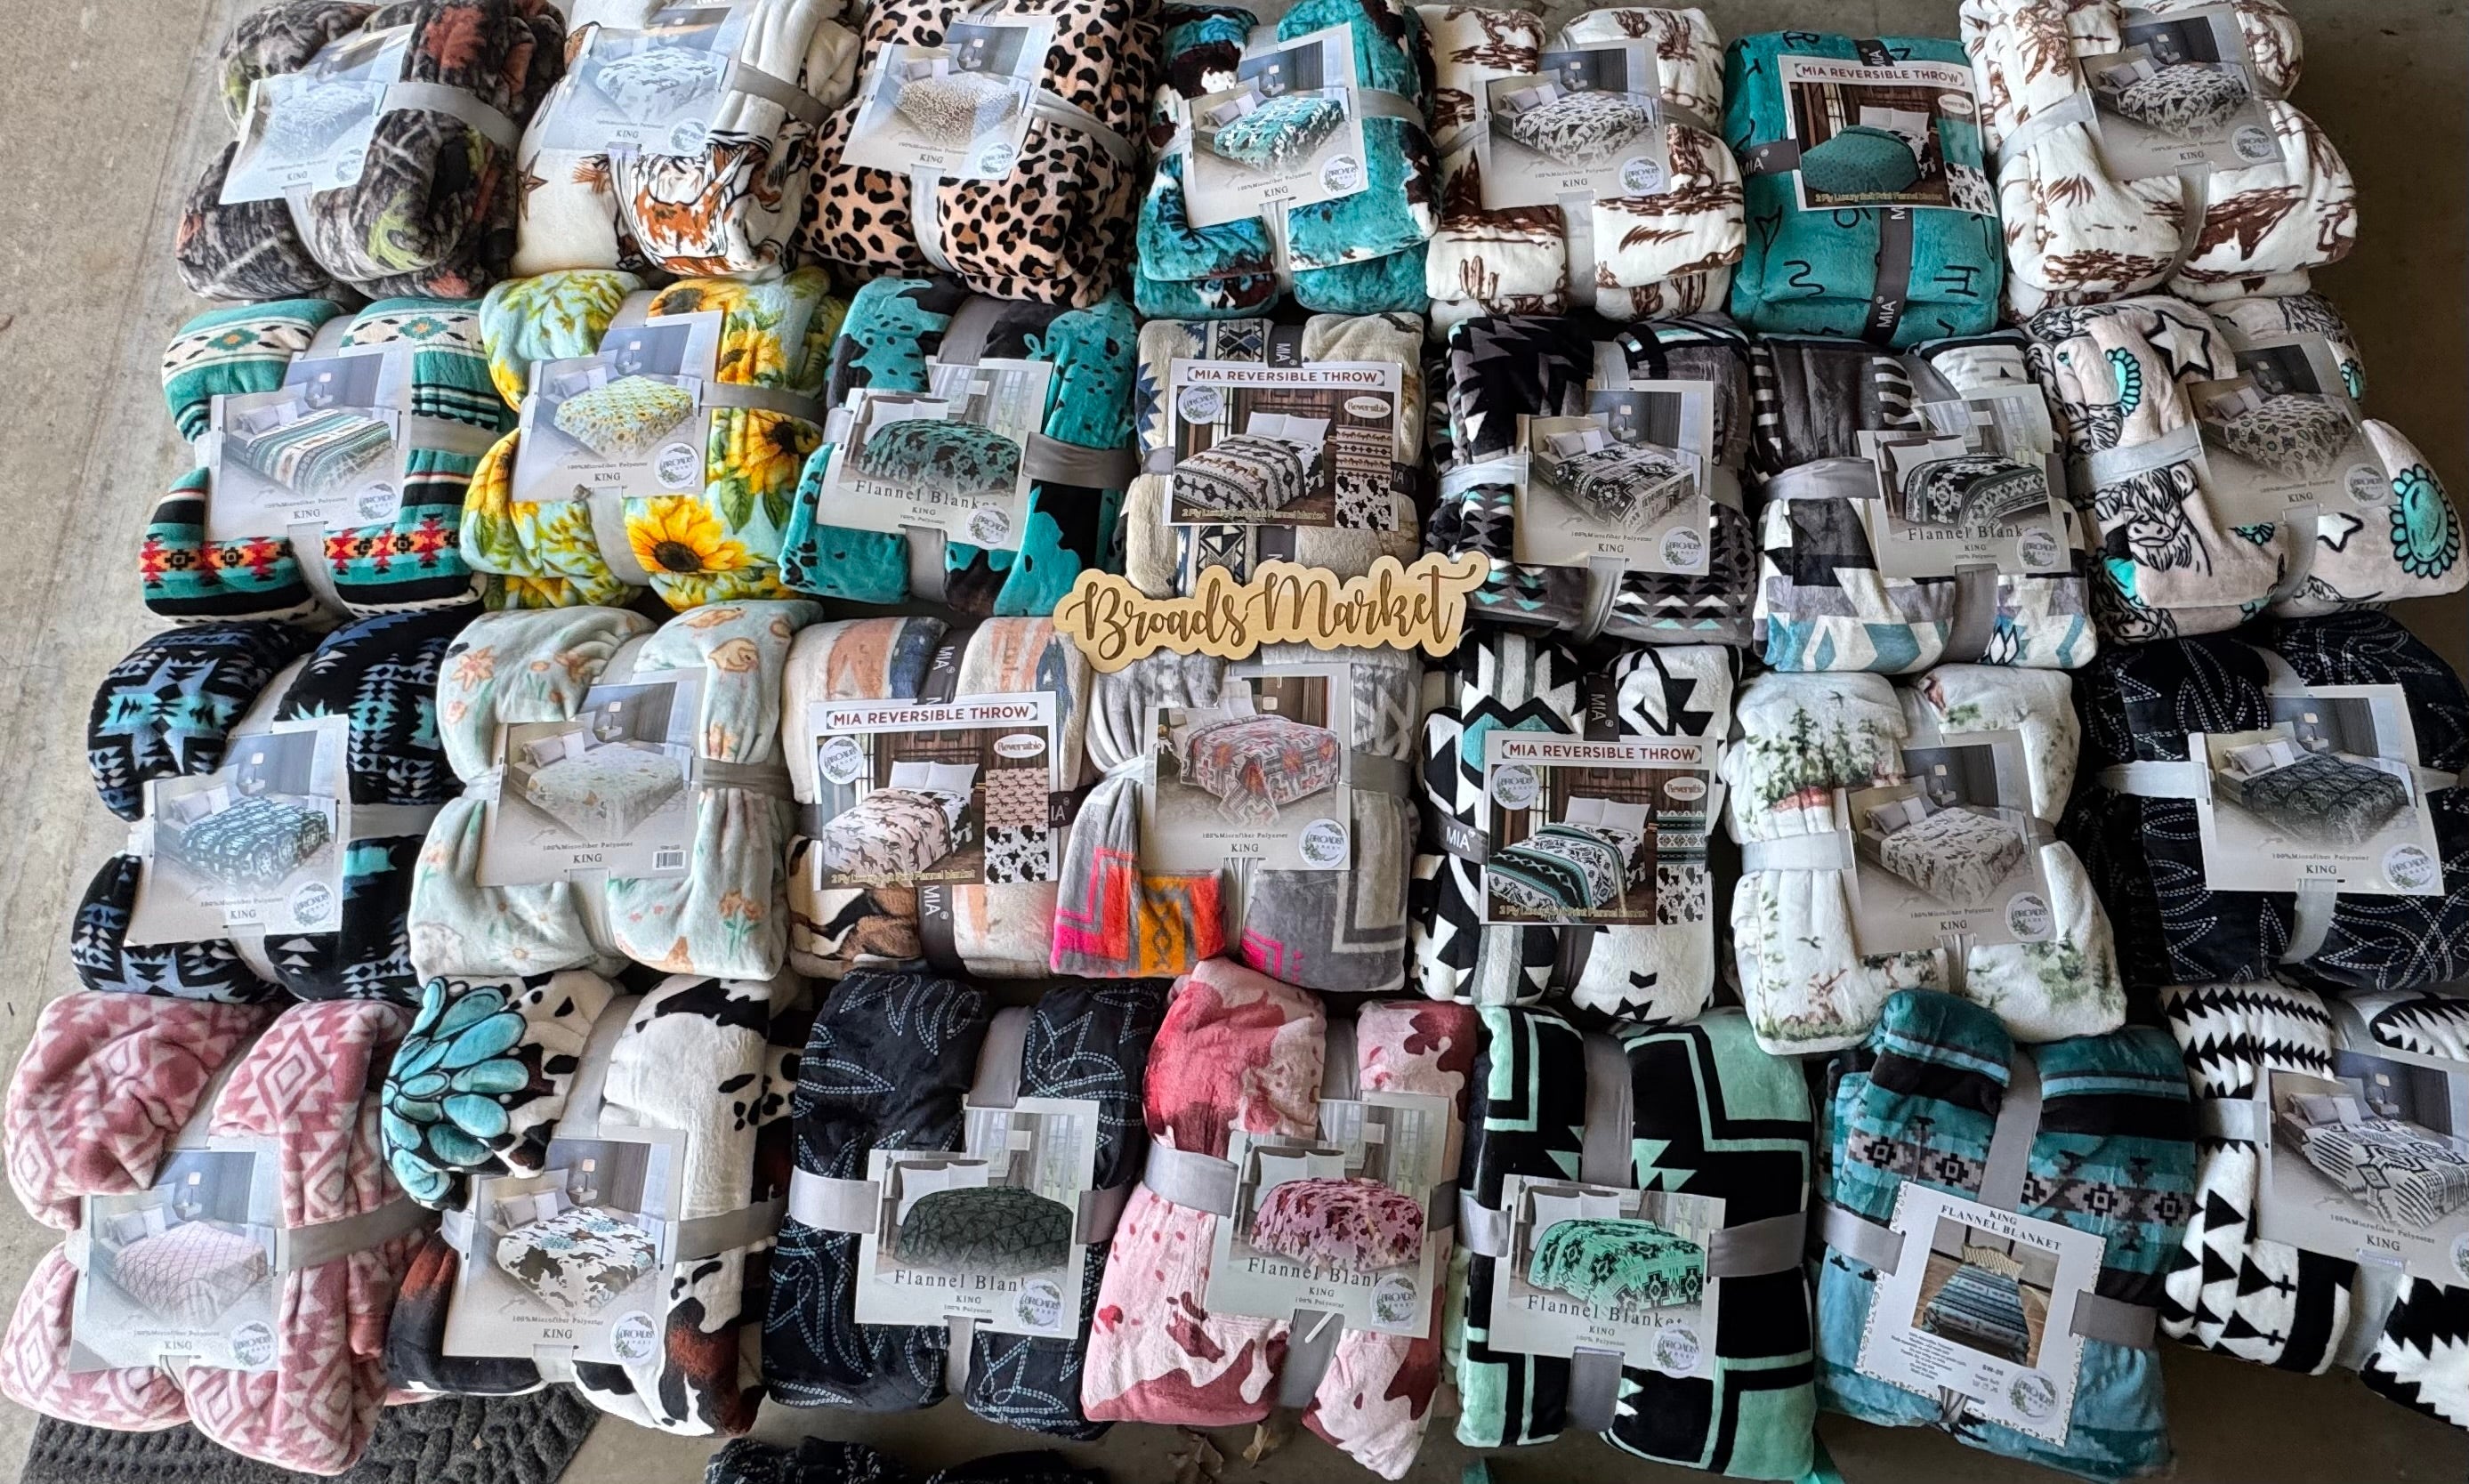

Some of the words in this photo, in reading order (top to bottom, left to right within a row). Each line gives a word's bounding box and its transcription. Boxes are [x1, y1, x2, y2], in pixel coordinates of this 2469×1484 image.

[1802, 65, 1827, 77] MIA
[1830, 67, 1909, 81] REVERSIBLE
[1915, 69, 1960, 84] THROW
[616, 130, 639, 139] KING
[918, 154, 943, 164] KING
[2179, 150, 2204, 160] KING
[1561, 178, 1588, 188] KING
[1263, 186, 1287, 198] KING
[1877, 300, 1898, 327] MIA
[1276, 343, 1291, 363] MIA
[1194, 369, 1222, 380] MIA
[1227, 370, 1317, 382] REVERSIBLE
[1322, 372, 1377, 383] THROW
[594, 472, 621, 481] KING
[854, 480, 922, 501] Flannel
[929, 488, 998, 510] Blank
[2287, 492, 2313, 503] KING
[294, 509, 321, 519] KING
[911, 506, 936, 516] KING
[1907, 526, 1969, 542] Flannel
[1597, 543, 1623, 553] KING
[1964, 544, 1987, 552] KING
[1065, 577, 1248, 660] Broads
[1247, 564, 1477, 644] Market
[932, 646, 956, 671] MIA
[1591, 693, 1607, 722] MIA
[834, 714, 862, 726] MIA
[867, 709, 964, 724] REVERSIBLE
[970, 706, 1029, 720] THROW
[1509, 744, 1538, 756] MIA
[1543, 745, 1634, 759] REVERSIBLE
[1640, 747, 1696, 761] THROW
[1446, 826, 1470, 851] MIA
[1230, 843, 1258, 852] KING
[572, 852, 601, 863] KING
[2305, 864, 2336, 875] KING
[924, 885, 940, 915] MIA
[230, 909, 256, 920] KING
[1941, 921, 1967, 931] KING
[1989, 1210, 2017, 1225] KING
[1941, 1205, 1998, 1231] FLANNEL
[2003, 1225, 2062, 1250] BLANKET
[2366, 1234, 2400, 1252] KING
[1247, 1258, 1319, 1281] Flannel
[1328, 1264, 1384, 1286] Blank
[893, 1269, 965, 1288] Flannel
[975, 1272, 1026, 1293] Blan
[1308, 1286, 1335, 1297] KING
[955, 1294, 980, 1304] KING
[1526, 1294, 1600, 1319] Flannel
[543, 1328, 572, 1339] KING
[1588, 1326, 1615, 1336] KING
[165, 1341, 192, 1351] KING
